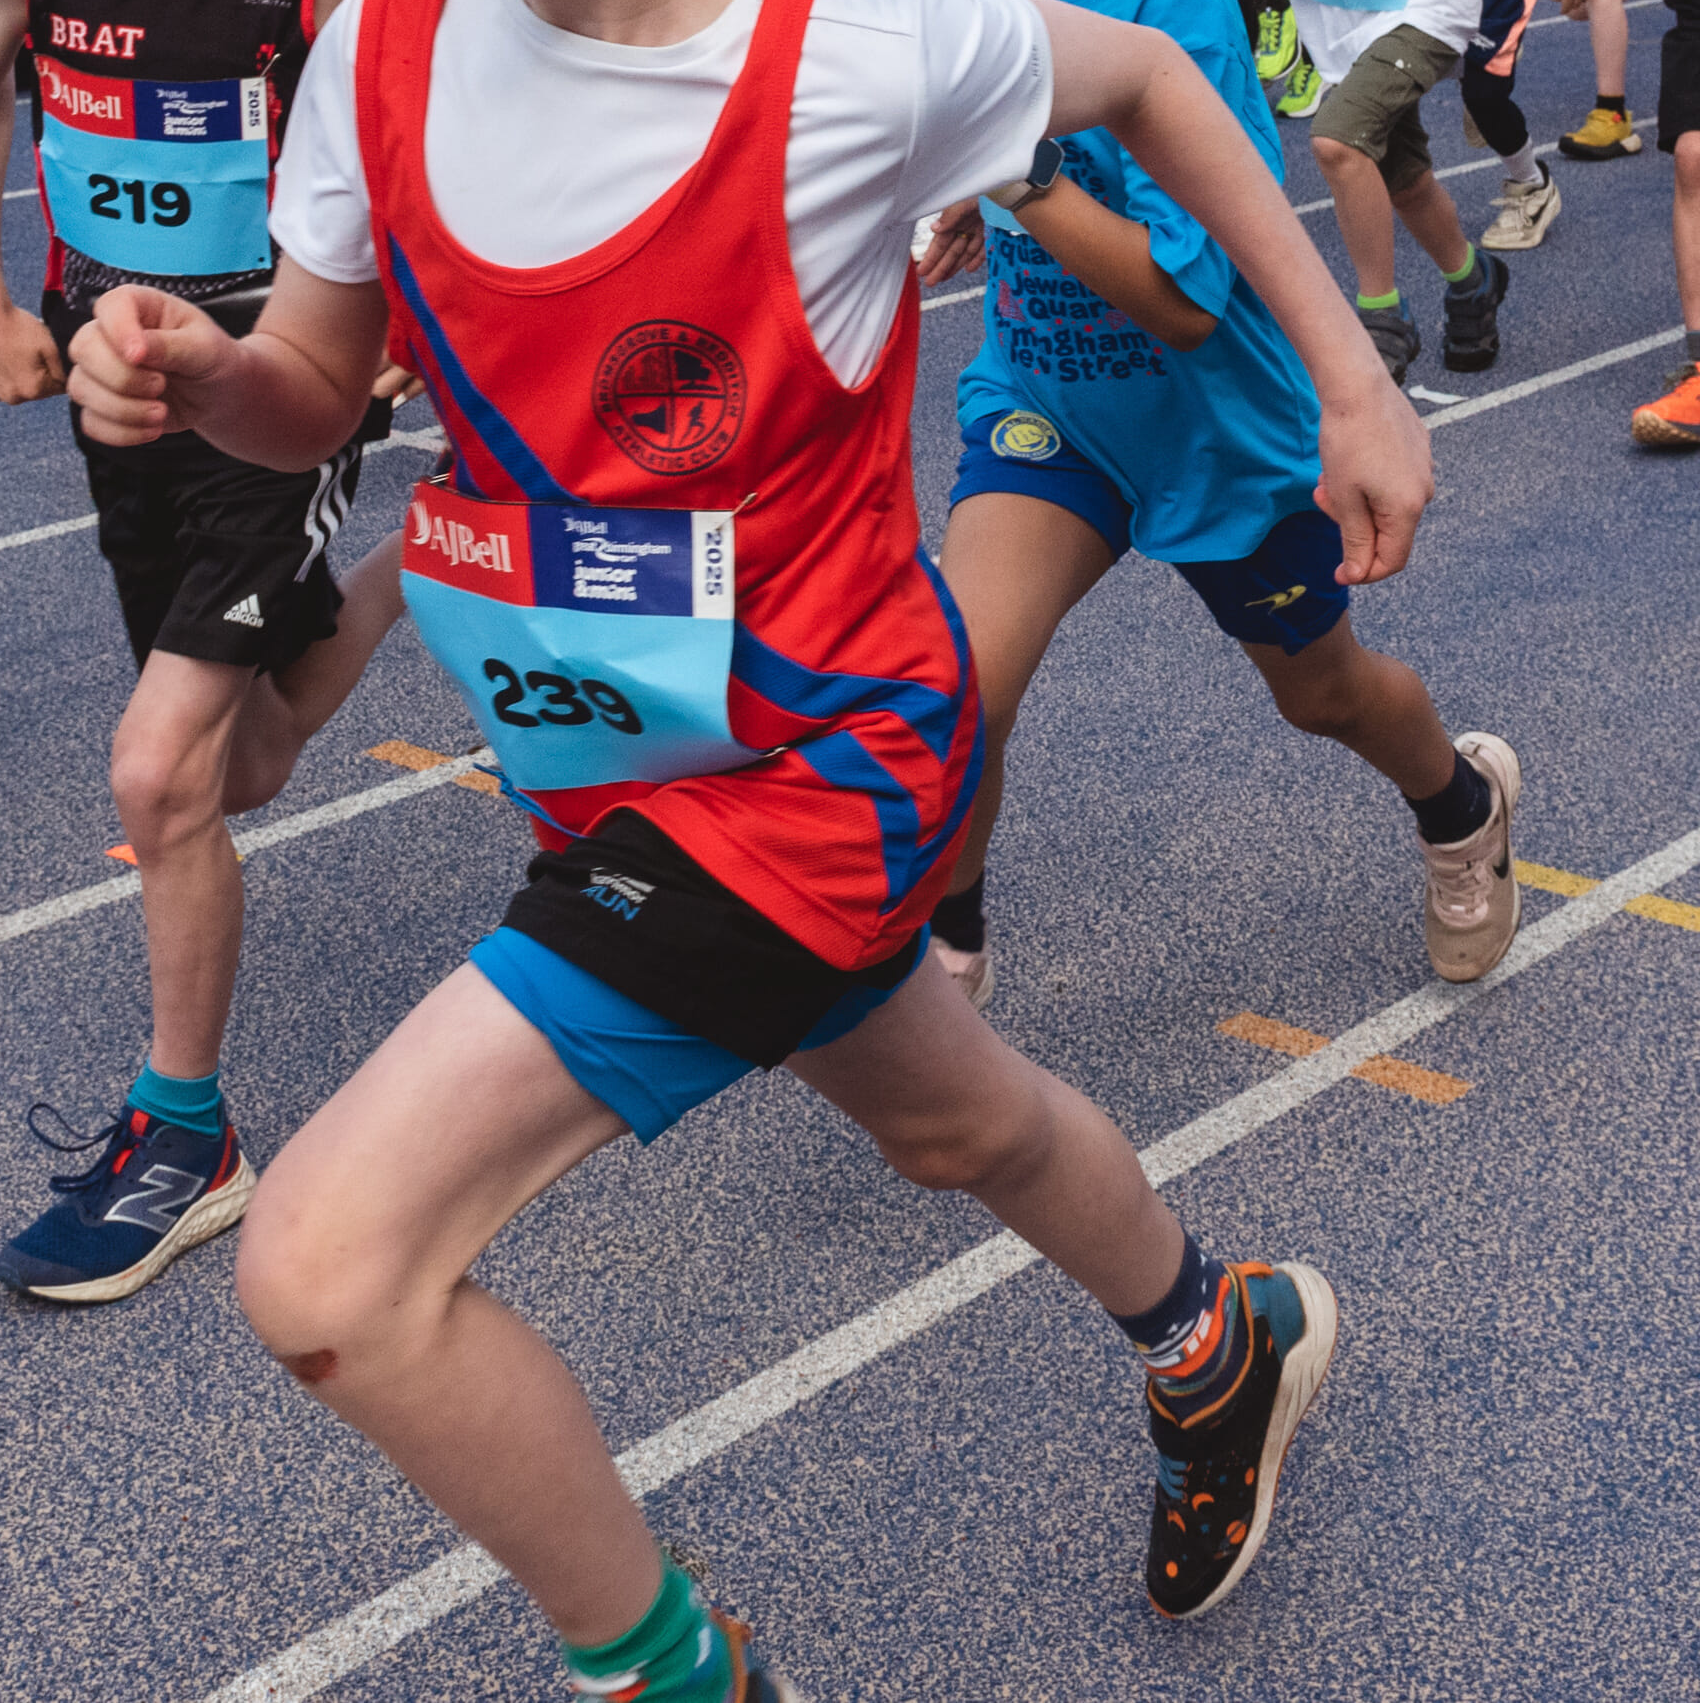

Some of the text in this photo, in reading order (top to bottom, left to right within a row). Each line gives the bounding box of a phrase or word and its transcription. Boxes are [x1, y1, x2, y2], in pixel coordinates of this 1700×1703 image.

[49, 12, 145, 61] BRAT
[58, 84, 123, 121] AJBell
[247, 89, 261, 128] 2025
[89, 174, 192, 228] 219
[1058, 349, 1168, 383] Street
[429, 516, 516, 573] AJBell
[704, 529, 724, 596] 2025
[483, 657, 644, 736] 239
